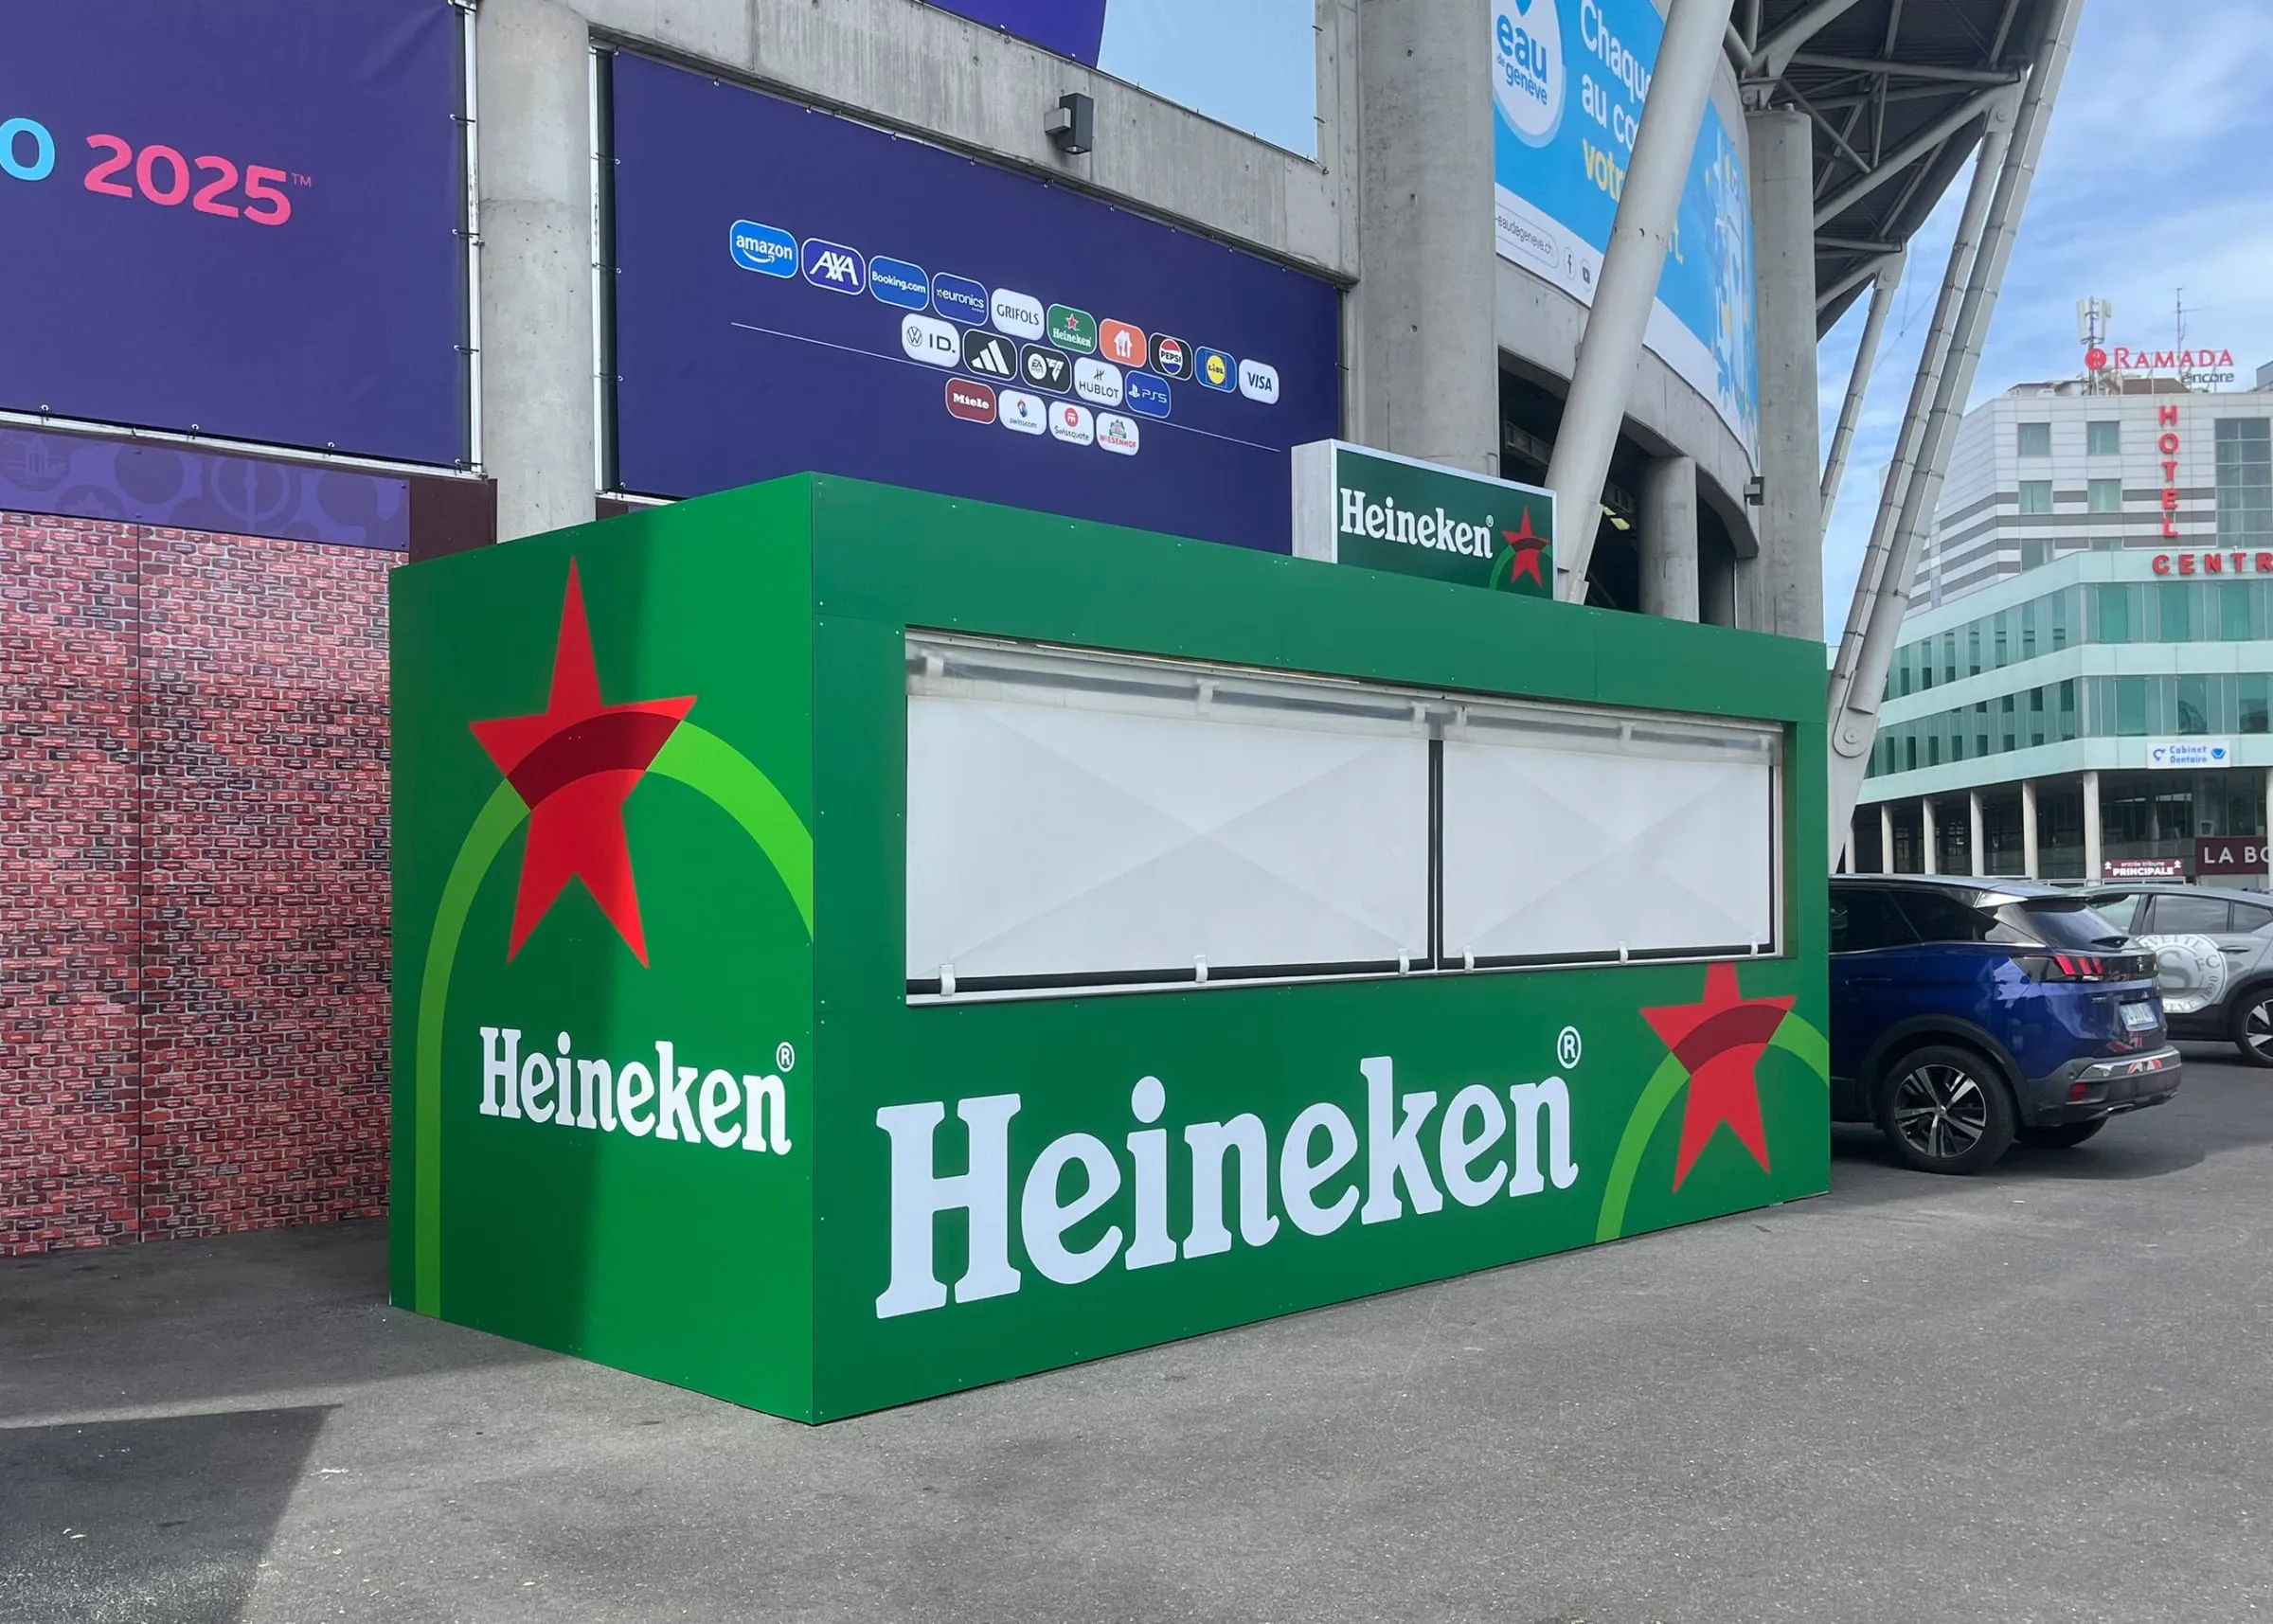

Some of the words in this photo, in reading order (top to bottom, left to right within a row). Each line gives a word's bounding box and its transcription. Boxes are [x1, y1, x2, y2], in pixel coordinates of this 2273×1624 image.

[1496, 14, 1548, 83] eau
[1582, 74, 1607, 129] au
[736, 234, 793, 261] amazon
[810, 250, 859, 286] AXA
[872, 271, 926, 294] Booking.com
[942, 290, 984, 308] euronics
[996, 303, 1040, 326] GRIFOLS
[1052, 328, 1091, 348] Heineken
[1160, 350, 1182, 364] PEPSI
[2114, 348, 2234, 369] RAMADA
[1246, 372, 1272, 392] VISA
[2181, 372, 2234, 384] encore
[1079, 381, 1119, 399] HUBLOT
[1141, 388, 1167, 403] PS5
[953, 392, 990, 410] Miele
[1054, 426, 1089, 441] Swissquote
[1100, 434, 1137, 448] WIESENHOF
[2158, 404, 2178, 538] HOTEL
[2152, 552, 2273, 575] CENTR
[2170, 745, 2207, 754] Cabinet
[2204, 846, 2234, 864] LA
[2112, 867, 2175, 877] PRINCIPALE
